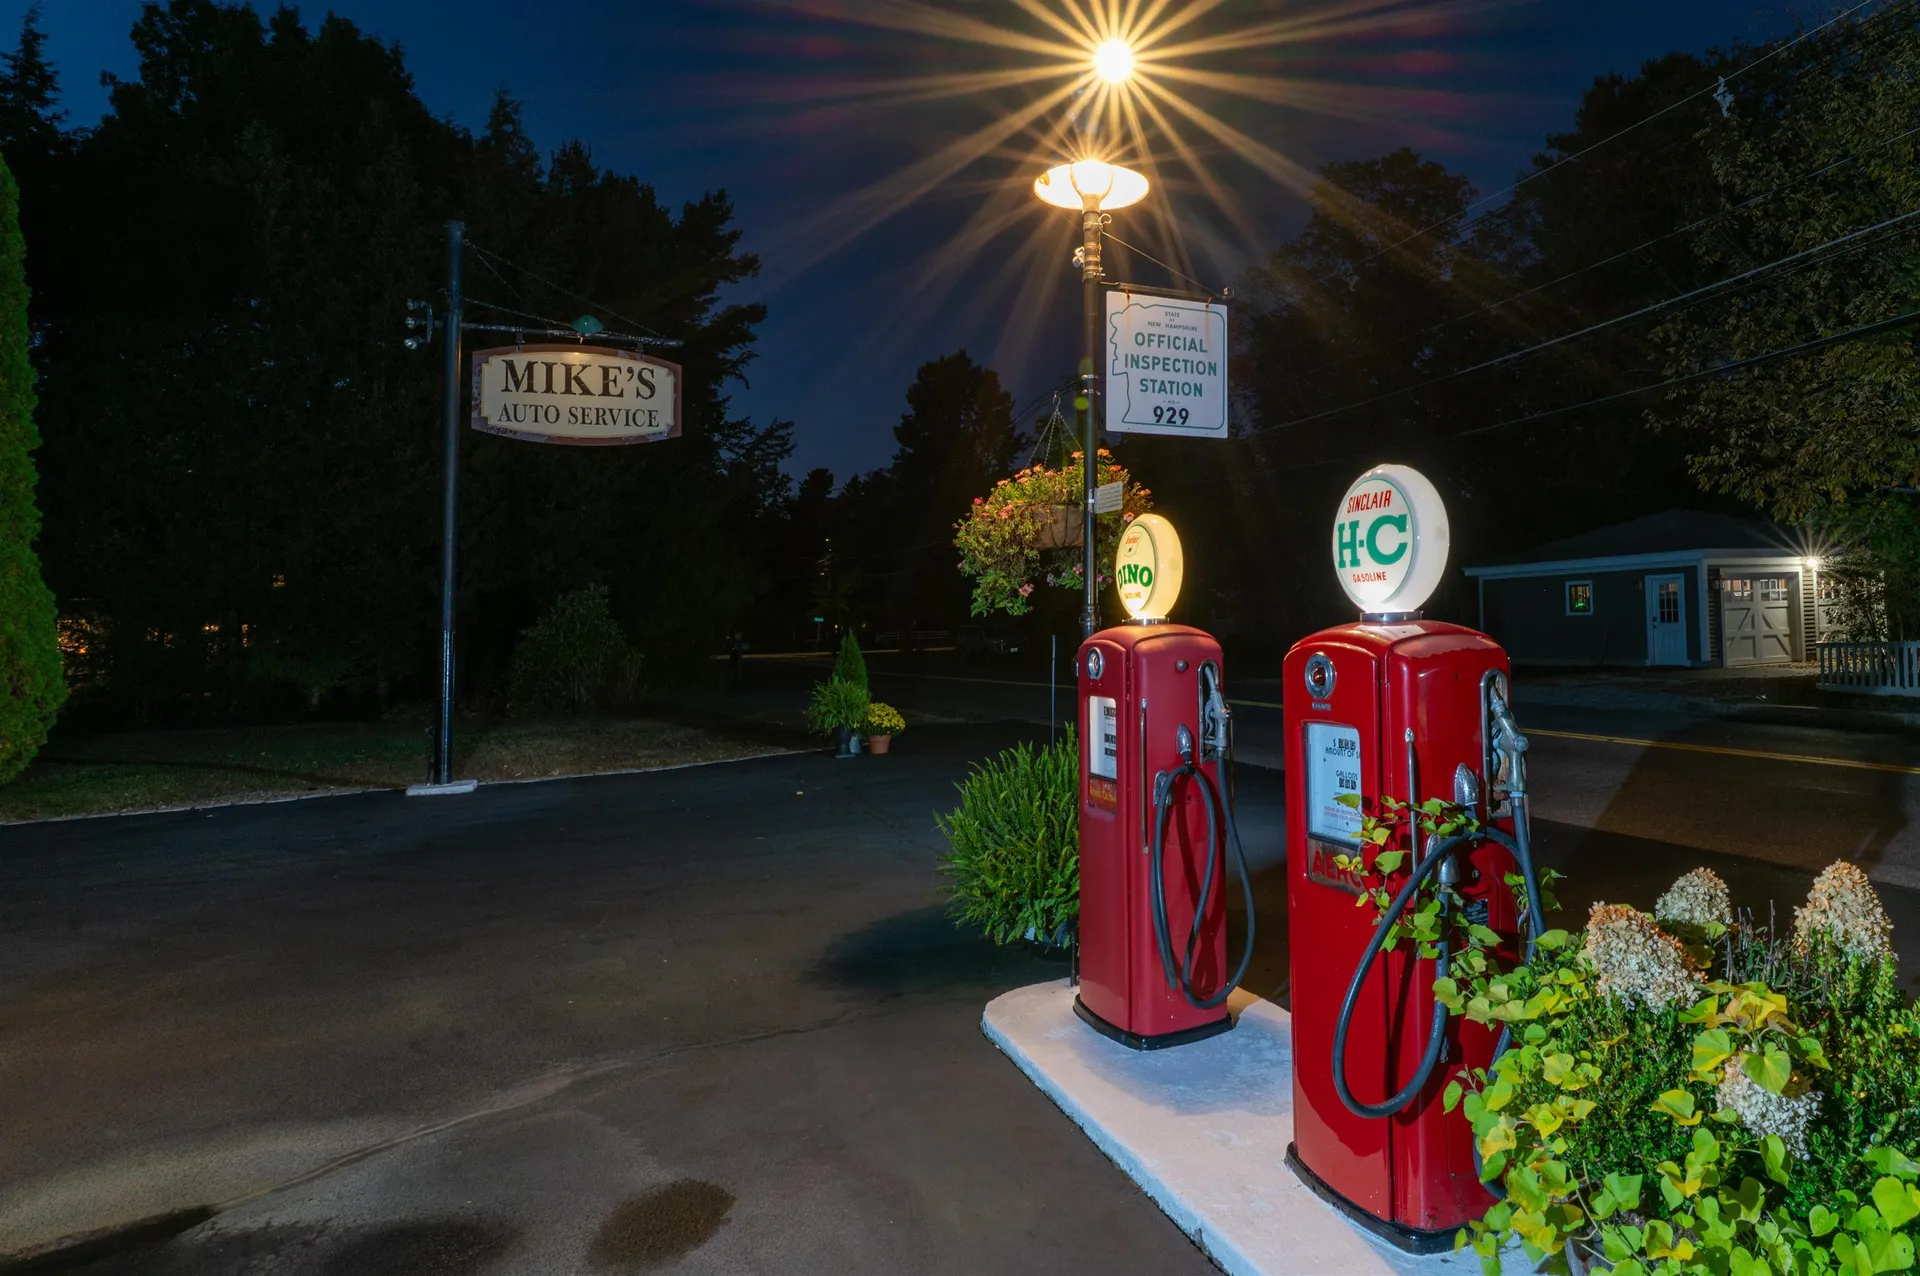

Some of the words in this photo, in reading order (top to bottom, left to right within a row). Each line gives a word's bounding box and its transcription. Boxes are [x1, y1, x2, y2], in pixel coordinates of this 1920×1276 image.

[1165, 323, 1198, 332] HAMPSHIRE
[1134, 332, 1208, 353] OFFICIAL
[1124, 353, 1217, 376] INSPECTION
[501, 359, 656, 400] MIKE'S
[1139, 378, 1203, 398] STATION
[498, 403, 560, 424] AUTO
[568, 406, 659, 428] SERVICE
[1153, 405, 1189, 425] 929
[1347, 489, 1392, 514] SINCLAIR
[1338, 513, 1408, 569] H-C
[1118, 563, 1153, 591] DINO
[1352, 571, 1387, 583] GASOLINE
[1335, 769, 1358, 781] GALLONS
